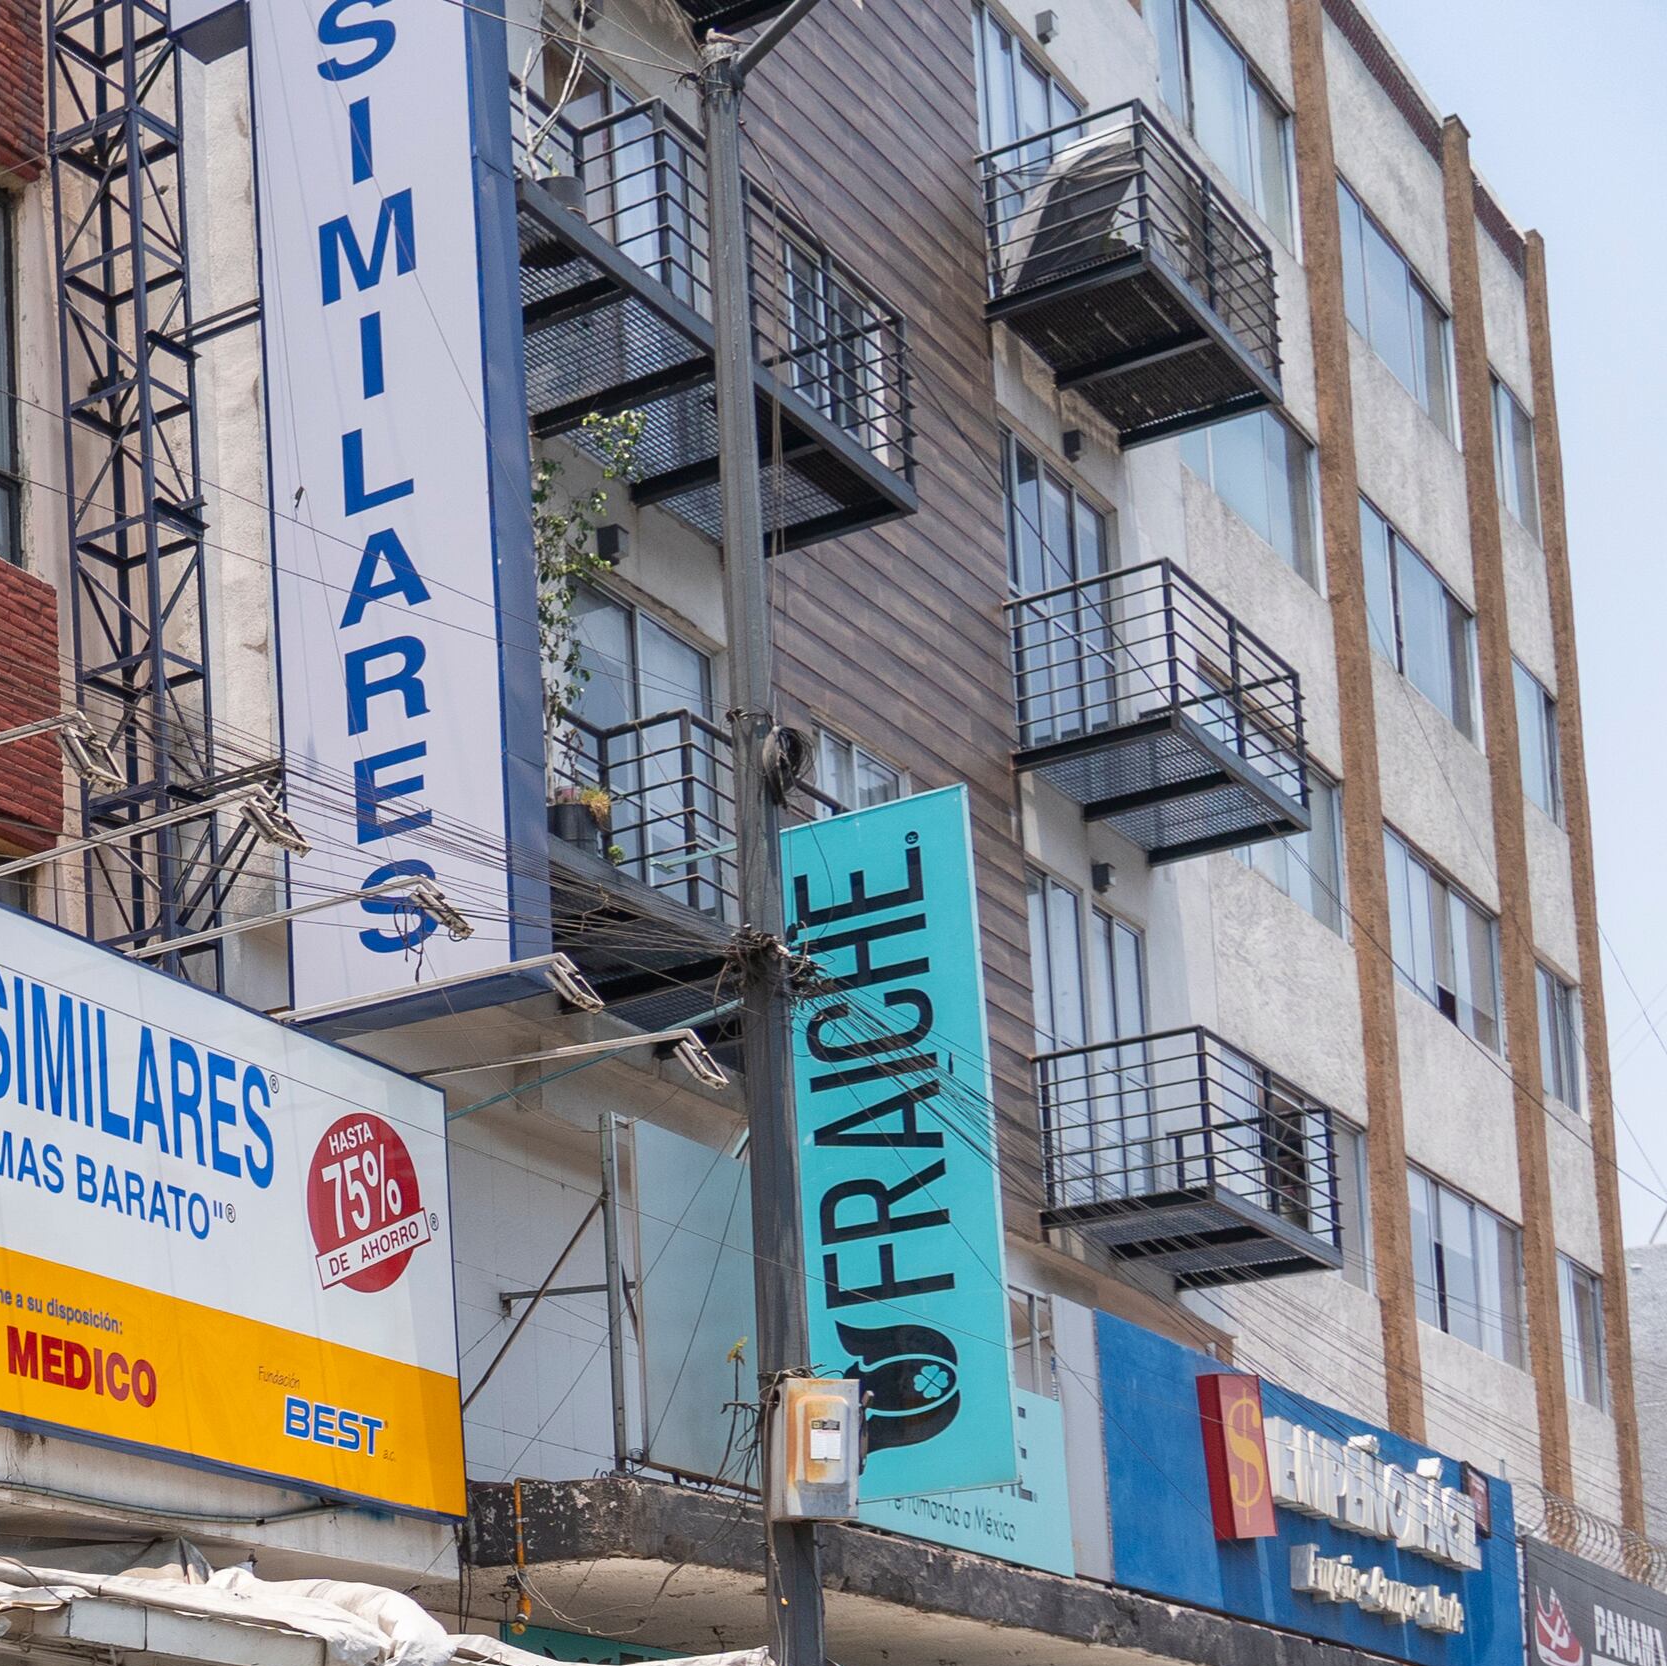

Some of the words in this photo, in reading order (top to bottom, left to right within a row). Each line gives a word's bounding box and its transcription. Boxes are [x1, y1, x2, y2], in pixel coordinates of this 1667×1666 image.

[316, 0, 439, 953] SIMILARES
[328, 1121, 373, 1156] HASTA
[321, 1143, 402, 1240] 75%
[328, 1252, 351, 1278] DE
[360, 1220, 420, 1264] AHORRO
[15, 1294, 24, 1310] a
[27, 1298, 45, 1315] su
[47, 1297, 124, 1336] disposición:
[6, 1325, 158, 1409] MEDICO
[257, 1364, 301, 1391] Fundación
[284, 1393, 385, 1458] BEST
[974, 1504, 1016, 1543] México
